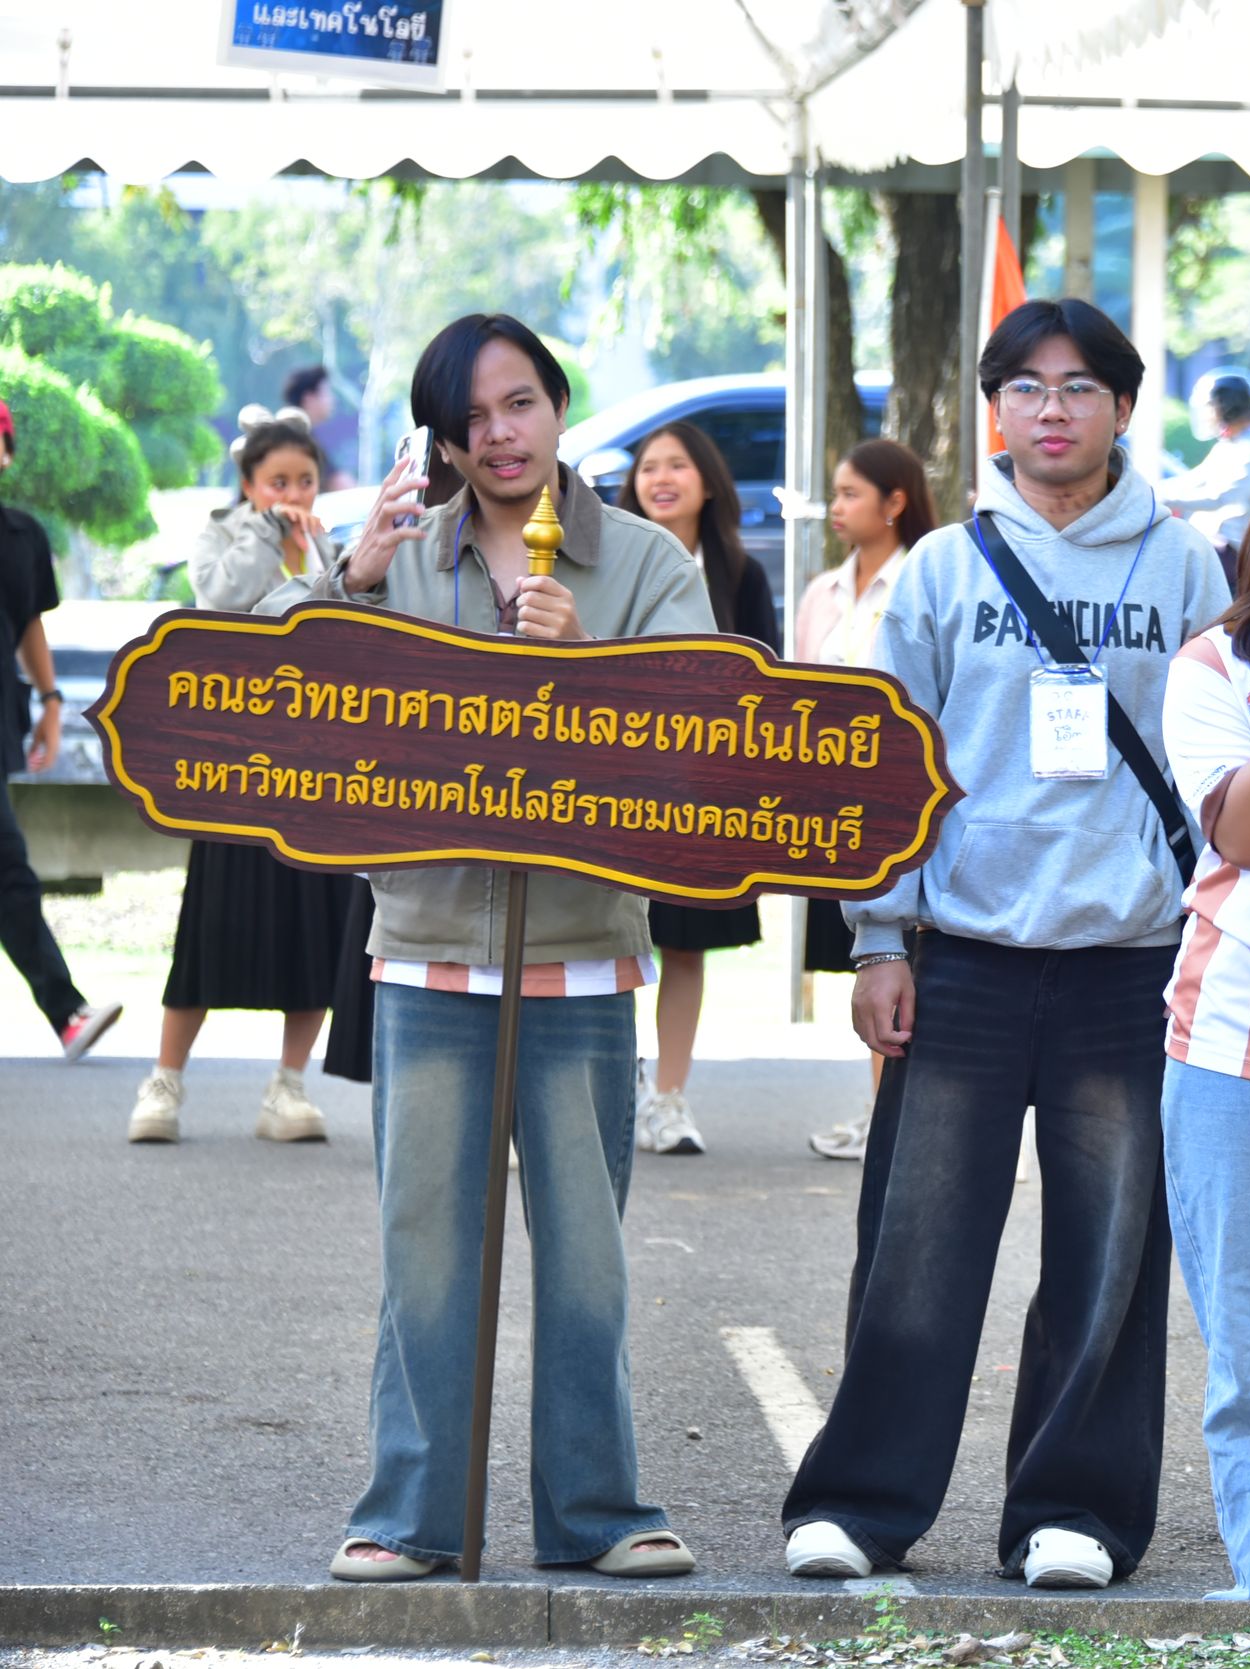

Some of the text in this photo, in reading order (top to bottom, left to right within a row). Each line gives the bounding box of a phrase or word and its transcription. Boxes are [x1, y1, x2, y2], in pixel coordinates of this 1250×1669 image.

[252, 1, 427, 41] และเทคโนโลยี
[973, 600, 1166, 653] BALNCIAGA
[168, 663, 881, 769] คณะวิทยาศาสตร์และเทคโนโลยี
[175, 753, 864, 864] มหาวิทยาลัยเทคโนโลยีราชมงคลธัญบุรี
